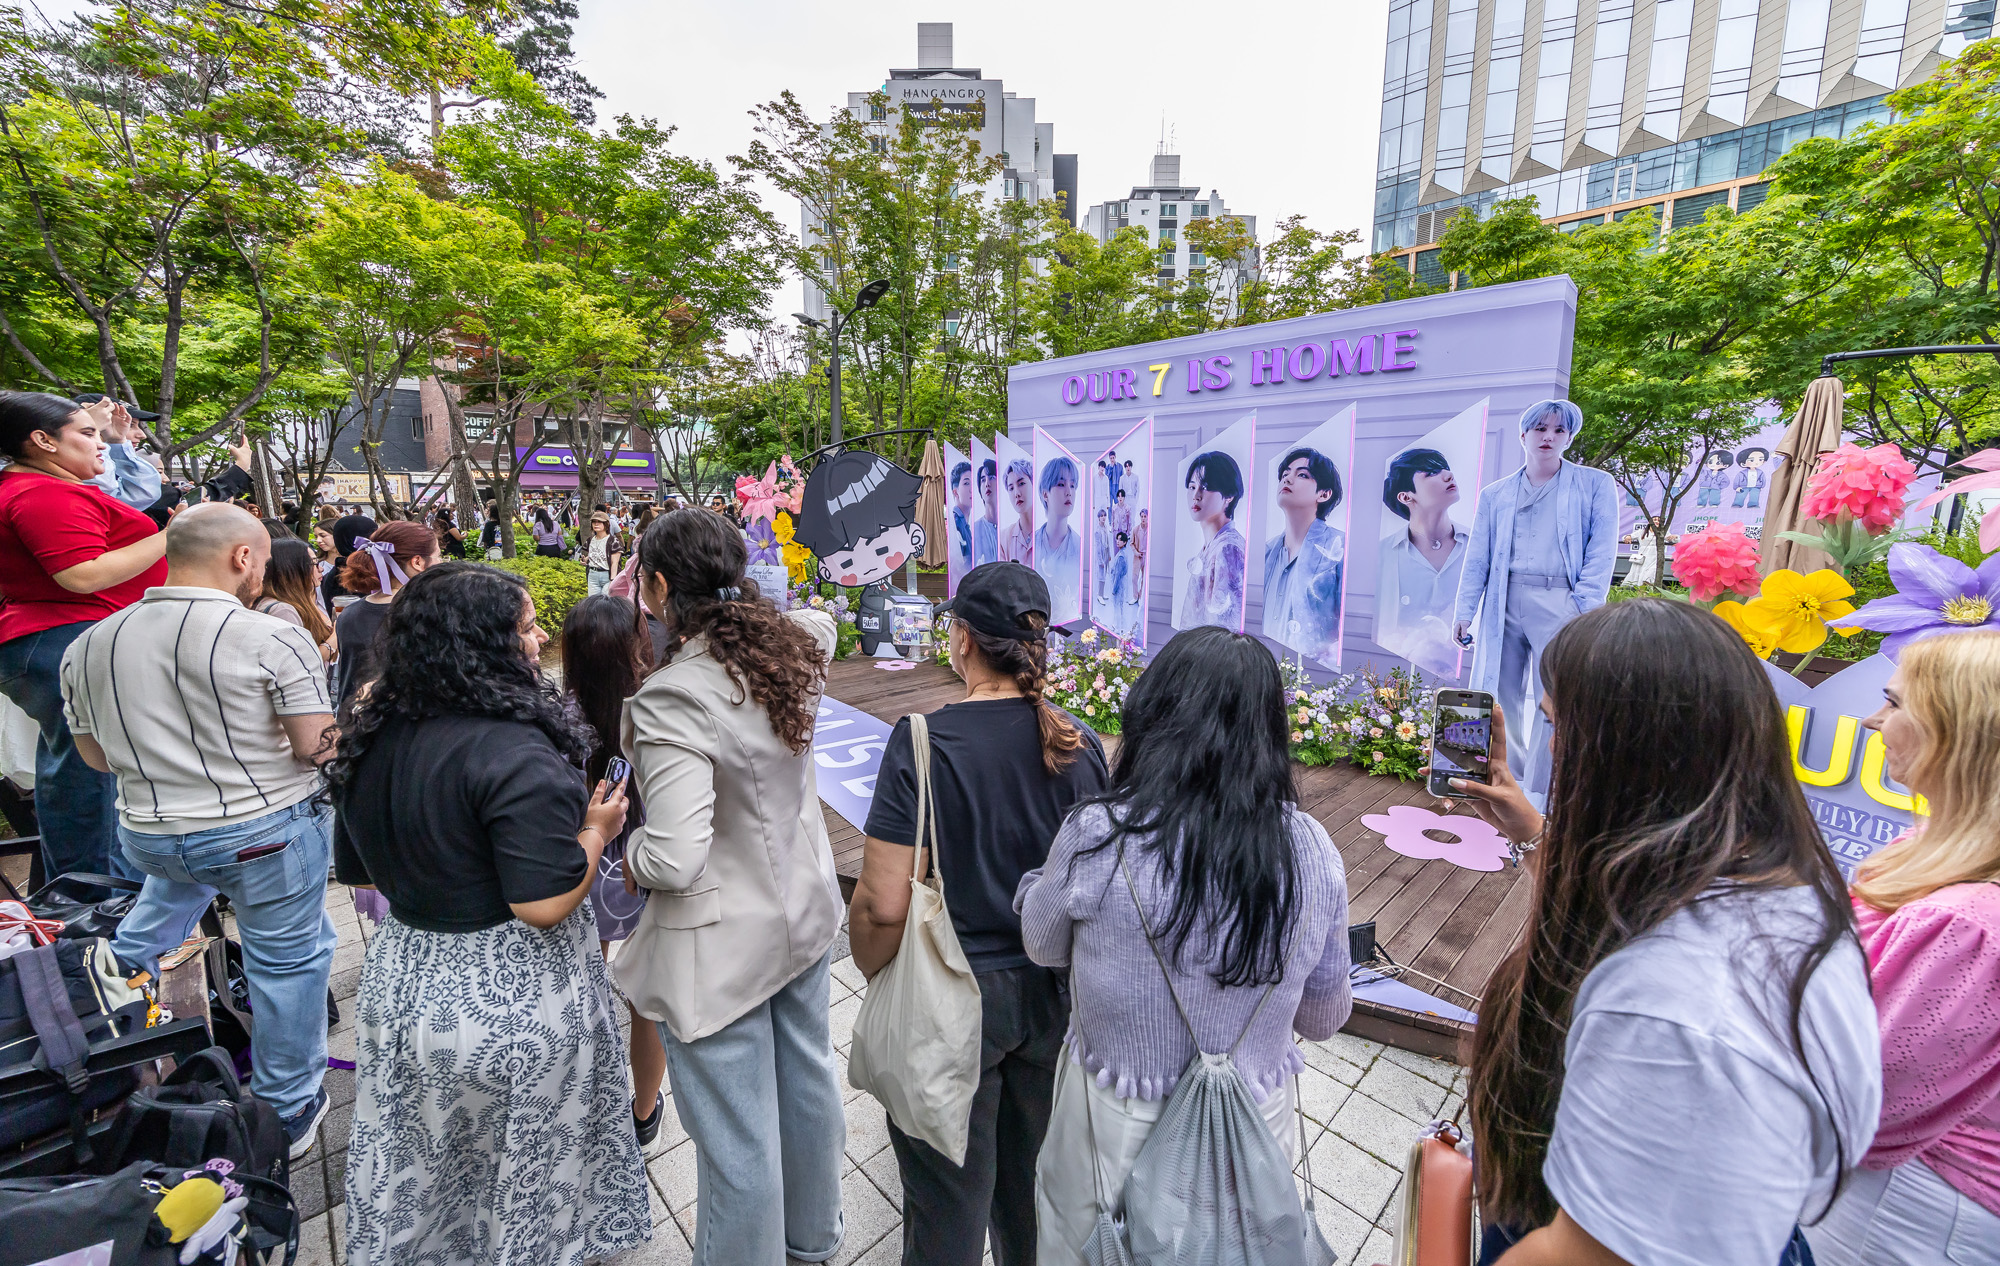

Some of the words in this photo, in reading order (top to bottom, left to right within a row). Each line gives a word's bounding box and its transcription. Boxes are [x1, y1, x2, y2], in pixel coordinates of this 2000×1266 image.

[903, 88, 986, 99] HANGANGRO
[1061, 368, 1137, 405] OUR
[1148, 362, 1171, 396] 7
[1187, 355, 1233, 393] IS
[1250, 328, 1420, 386] HOME
[898, 632, 925, 641] ARMY
